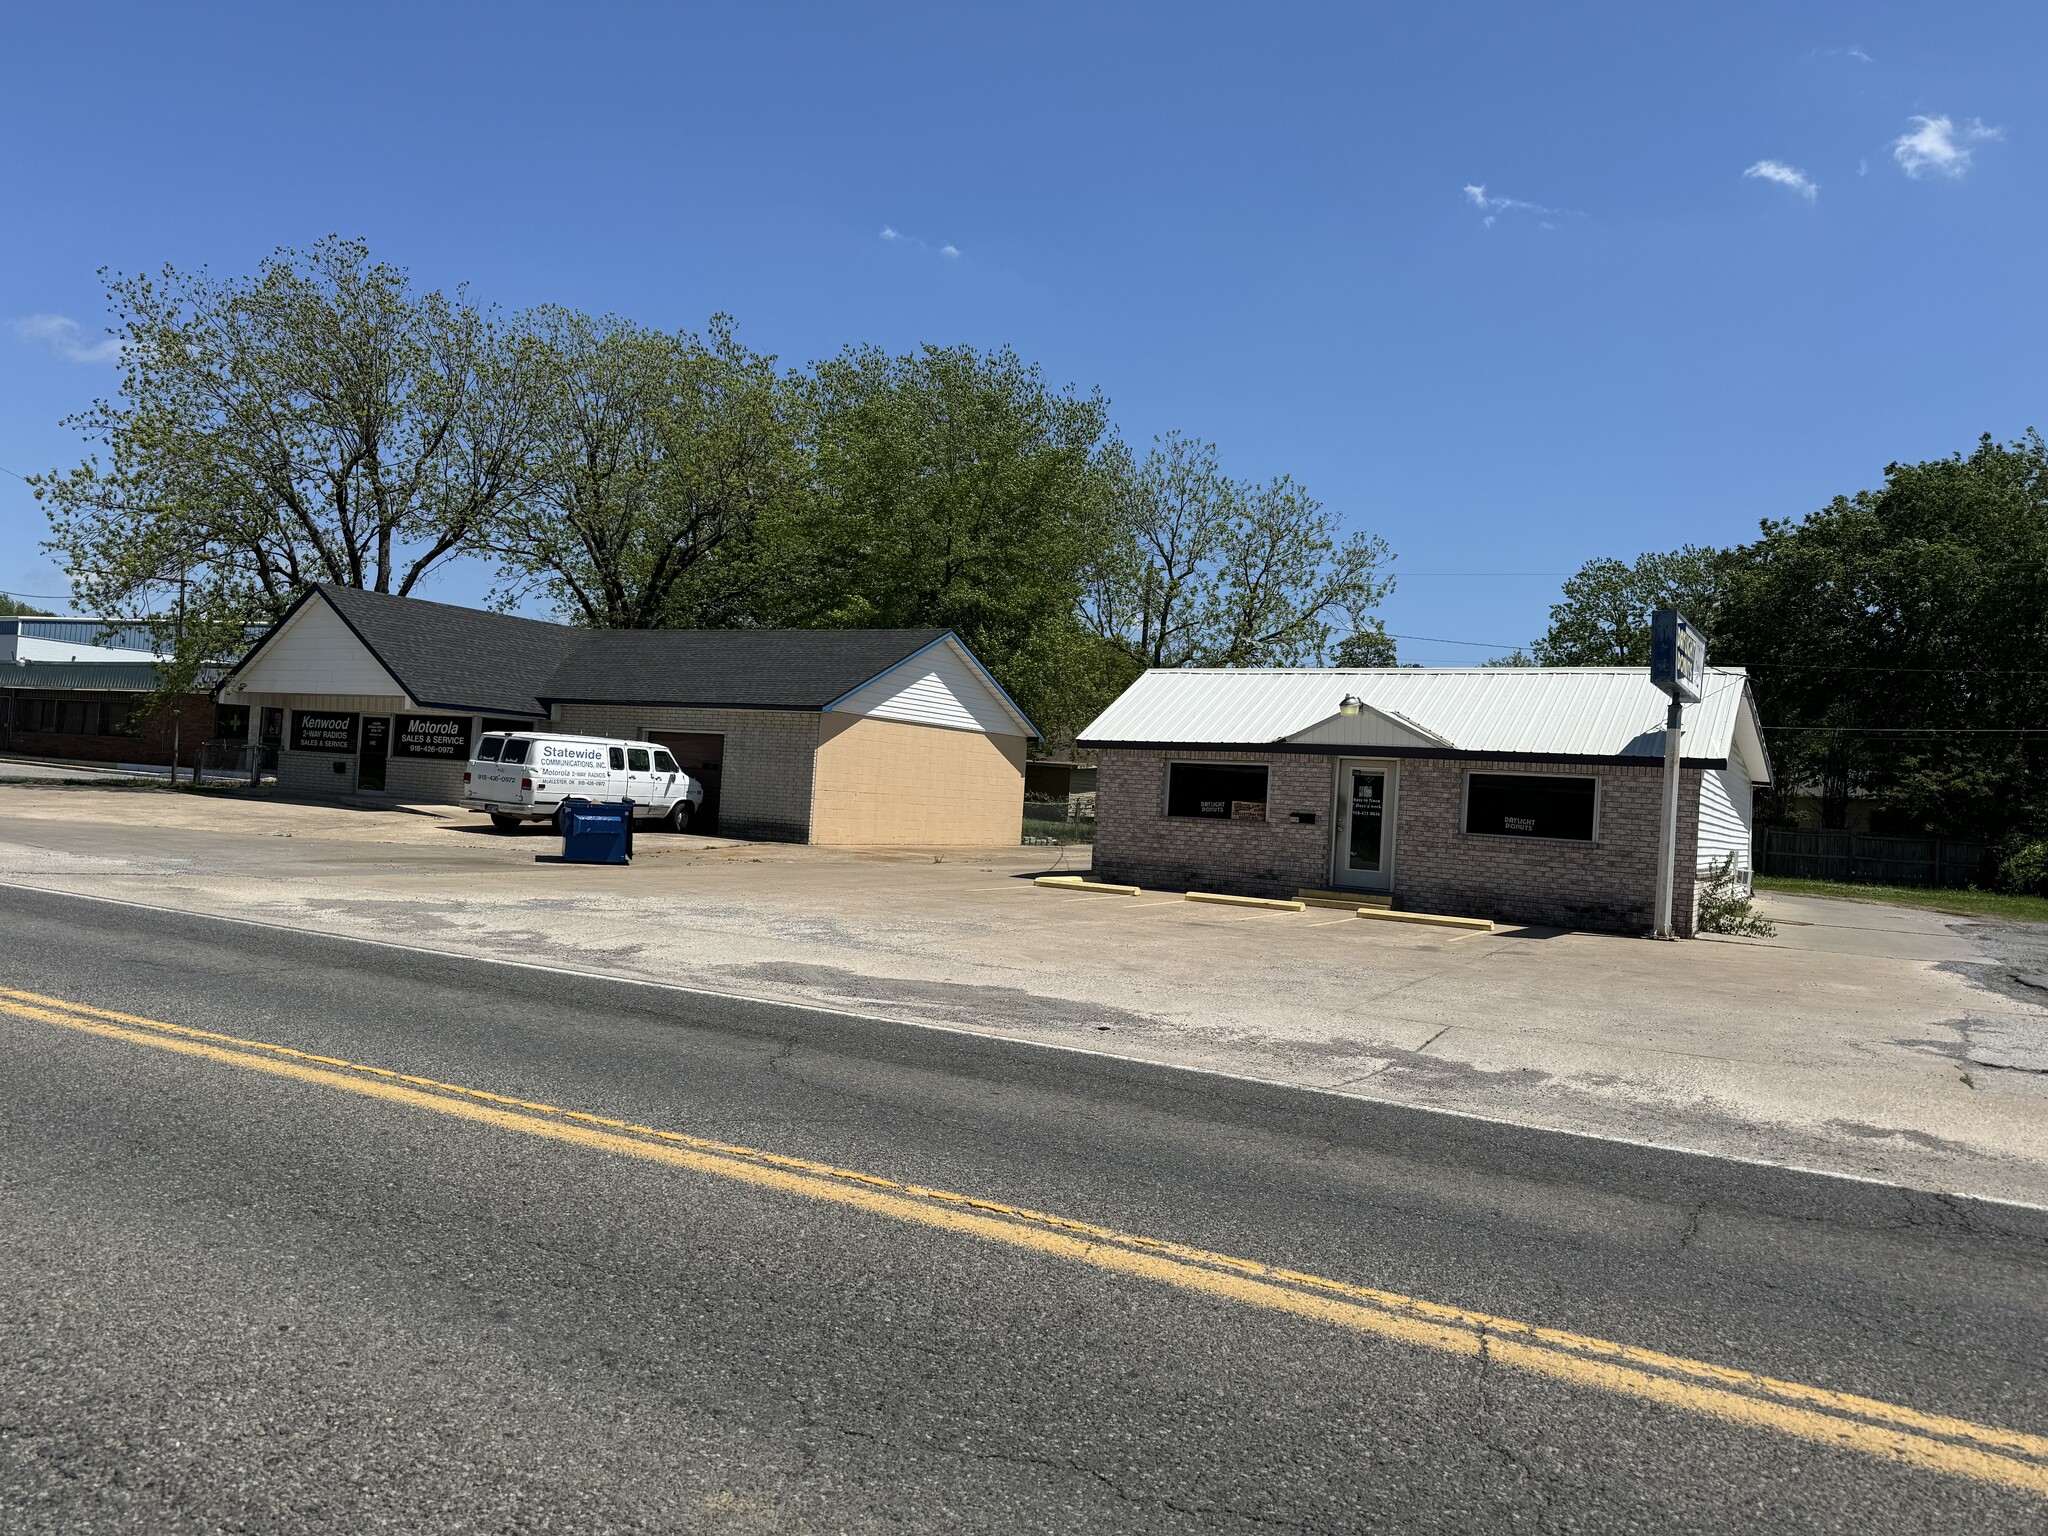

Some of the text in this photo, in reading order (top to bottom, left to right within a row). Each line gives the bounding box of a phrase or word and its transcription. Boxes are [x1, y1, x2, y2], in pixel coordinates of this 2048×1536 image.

[302, 715, 349, 730] Kenwood
[408, 719, 458, 734] Motorola
[303, 730, 347, 739] 2-WAY RADIOS
[324, 740, 348, 748] SERVICE
[401, 734, 464, 745] SALES & SERVICE
[410, 744, 454, 754] 918-426-0972
[543, 746, 602, 760] Statewide
[541, 758, 596, 769] COMMUNICATIONS,
[542, 768, 570, 777] Motorola
[477, 774, 516, 783] 918-426-0972
[1504, 816, 1536, 825] DAYLIGHT
[1505, 823, 1533, 831] DONUTS
